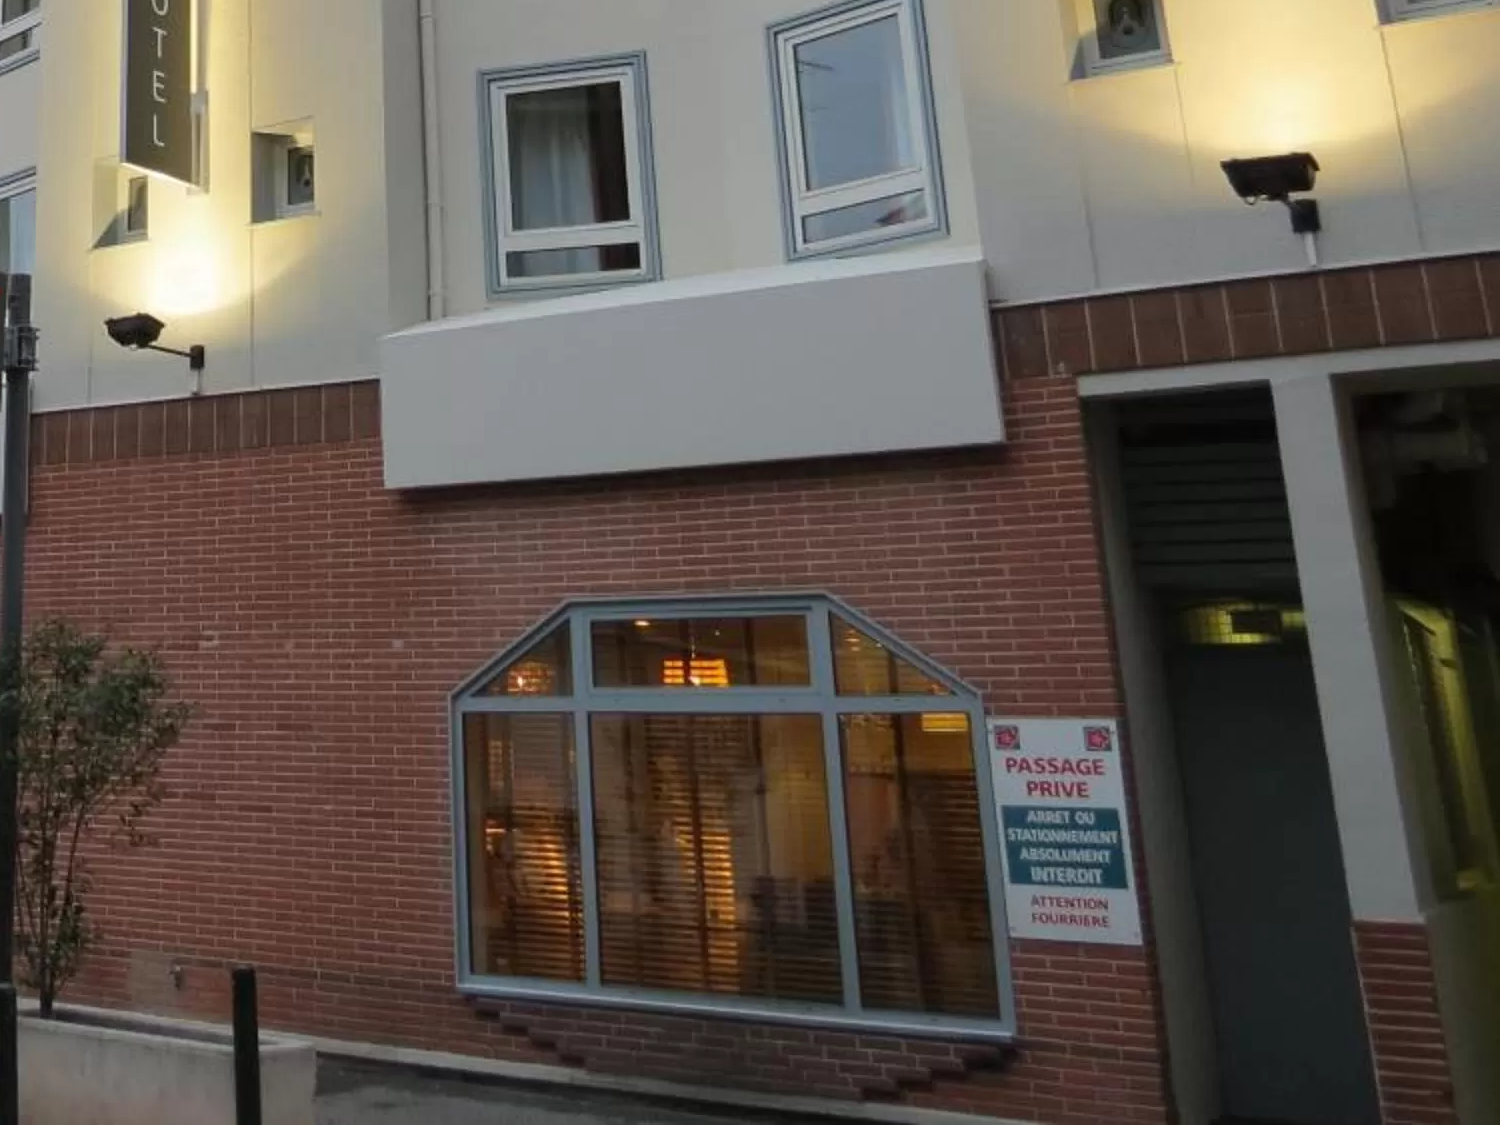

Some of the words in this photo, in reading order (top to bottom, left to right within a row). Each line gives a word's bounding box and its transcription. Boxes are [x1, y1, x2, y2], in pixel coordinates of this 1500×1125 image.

[1005, 757, 1106, 776] PASSAGE
[1026, 780, 1090, 798] PRIVE
[1027, 810, 1071, 824] ARRET
[1074, 811, 1096, 825] OU
[1007, 828, 1118, 844] STATIONNEMENT
[1020, 847, 1112, 864] ABSOLUMENT
[1030, 866, 1104, 885] INTERDIT
[1031, 895, 1109, 911] ATTENTION
